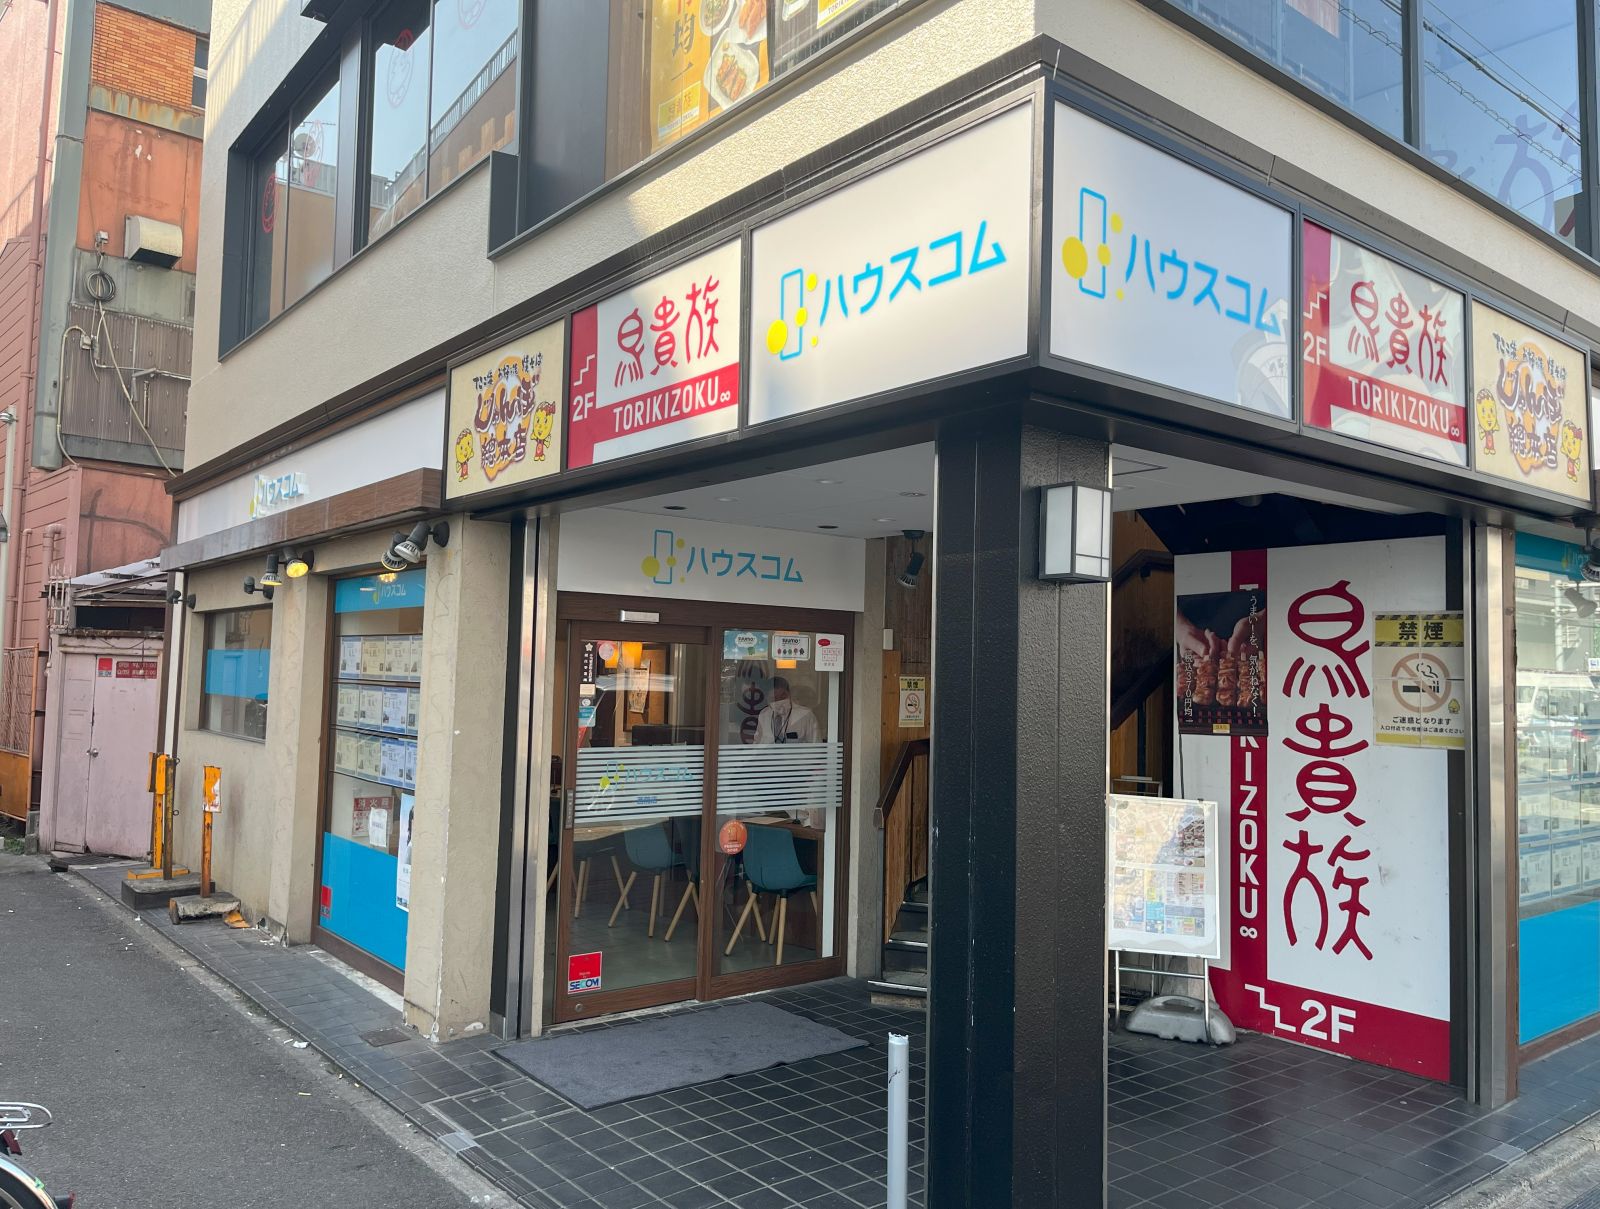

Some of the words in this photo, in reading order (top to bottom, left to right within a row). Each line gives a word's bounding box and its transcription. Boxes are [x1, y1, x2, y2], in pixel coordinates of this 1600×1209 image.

[819, 220, 1007, 327] ハウスコム
[1125, 234, 1281, 336] ハウスコム
[614, 275, 720, 388] 鳥貴族
[1303, 331, 1327, 367] 2F
[1348, 280, 1448, 387] 鳥貴族
[572, 392, 595, 422] 2F
[613, 375, 719, 433] TORIKIZOKU
[1348, 376, 1450, 434] TORIKIZOKU
[687, 546, 804, 583] ハウスコム
[1398, 621, 1444, 641] 禁煙
[626, 766, 693, 783] ハウスコム
[1282, 580, 1371, 960] 鳥貴族
[570, 977, 599, 990] SECOM
[1300, 999, 1357, 1044] 2F
